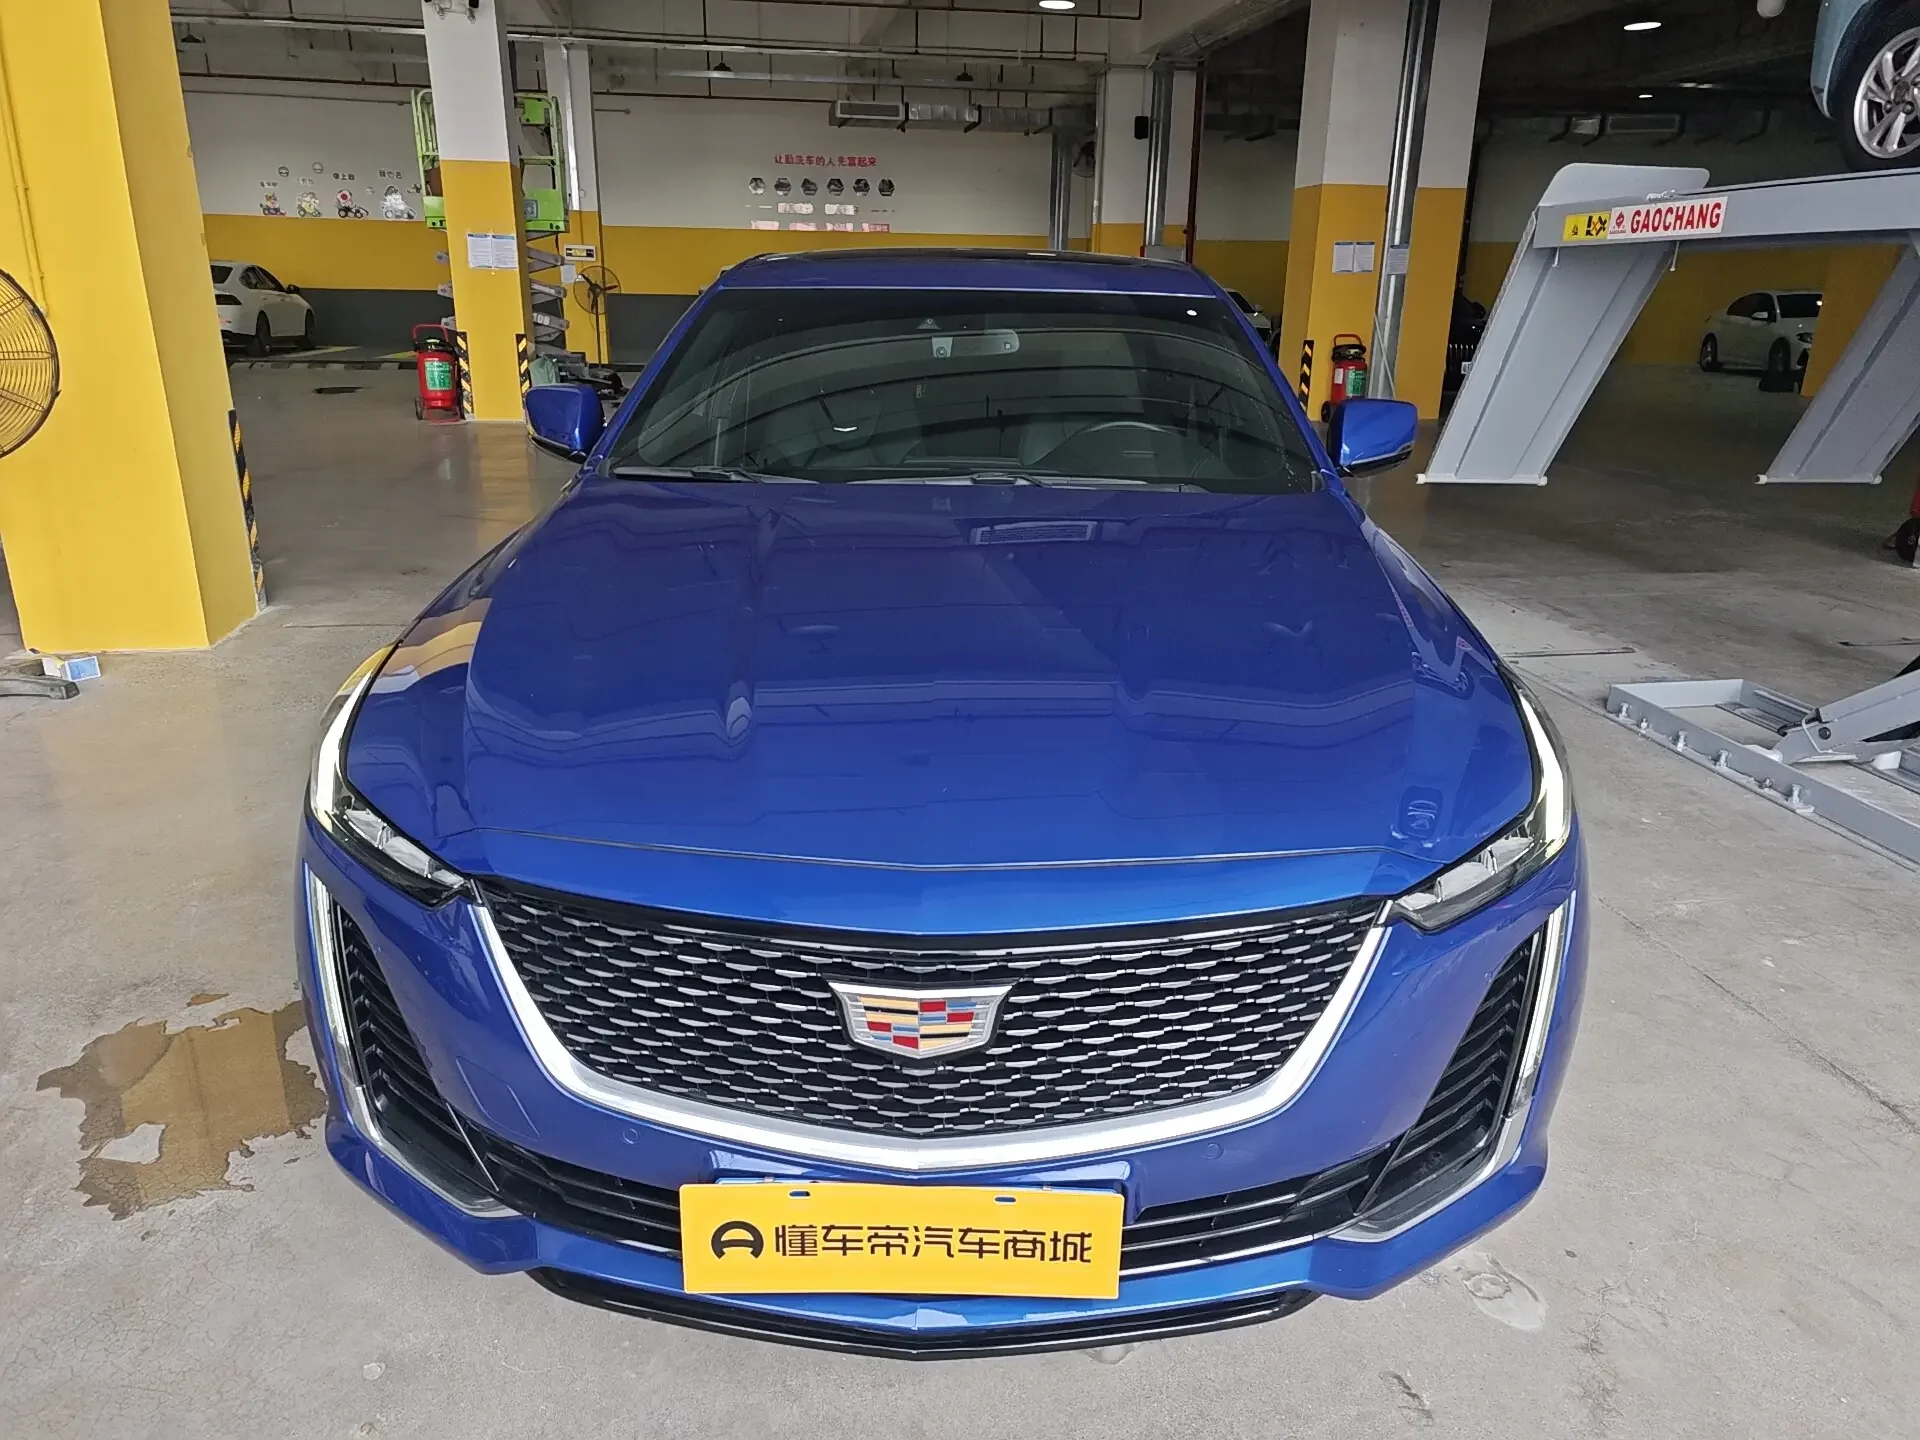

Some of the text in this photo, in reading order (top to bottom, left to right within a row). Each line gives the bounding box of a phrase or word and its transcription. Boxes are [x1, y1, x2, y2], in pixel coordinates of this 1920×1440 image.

[774, 154, 877, 167] 让勤洗车的人先富起来
[1630, 202, 1722, 234] GAOCHANG
[774, 1224, 1093, 1263] 懂车帝汽车商城
